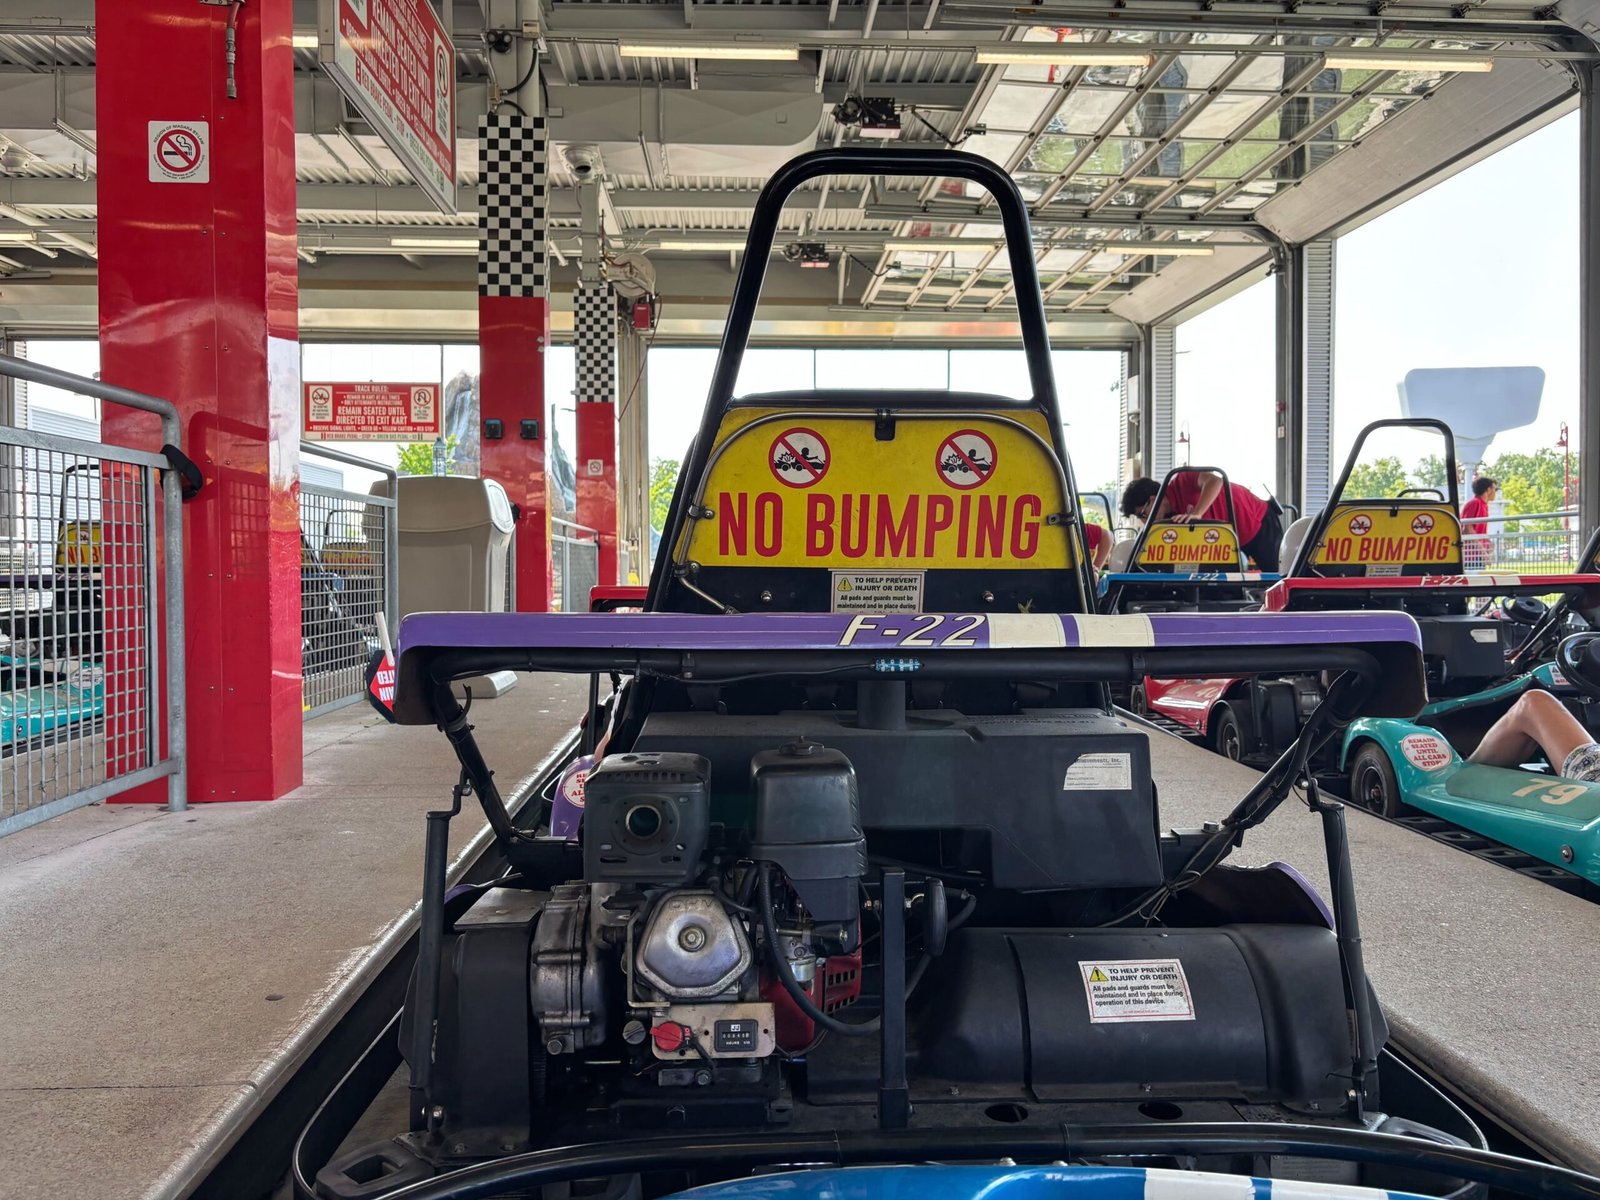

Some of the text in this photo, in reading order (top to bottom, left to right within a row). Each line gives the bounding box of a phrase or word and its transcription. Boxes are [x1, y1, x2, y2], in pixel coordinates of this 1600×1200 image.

[372, 0, 396, 49] REMAIN
[396, 28, 417, 80] SEATED
[418, 60, 432, 104] UNTIL
[371, 19, 434, 132] DIRECTED TO EXIT KART
[336, 416, 408, 425] DIRECTED TO EXIT KART
[338, 406, 362, 416] REMAIN
[362, 406, 387, 416] SEATED
[388, 406, 406, 416] UNTIL
[718, 492, 1042, 560] NO BUMPING
[1147, 544, 1231, 562] NO BUMPING
[1325, 536, 1450, 562] NO BUMPING
[1189, 572, 1220, 581] F-22
[1420, 576, 1464, 586] F-22
[836, 614, 987, 648] F-22
[1512, 778, 1588, 805] 79
